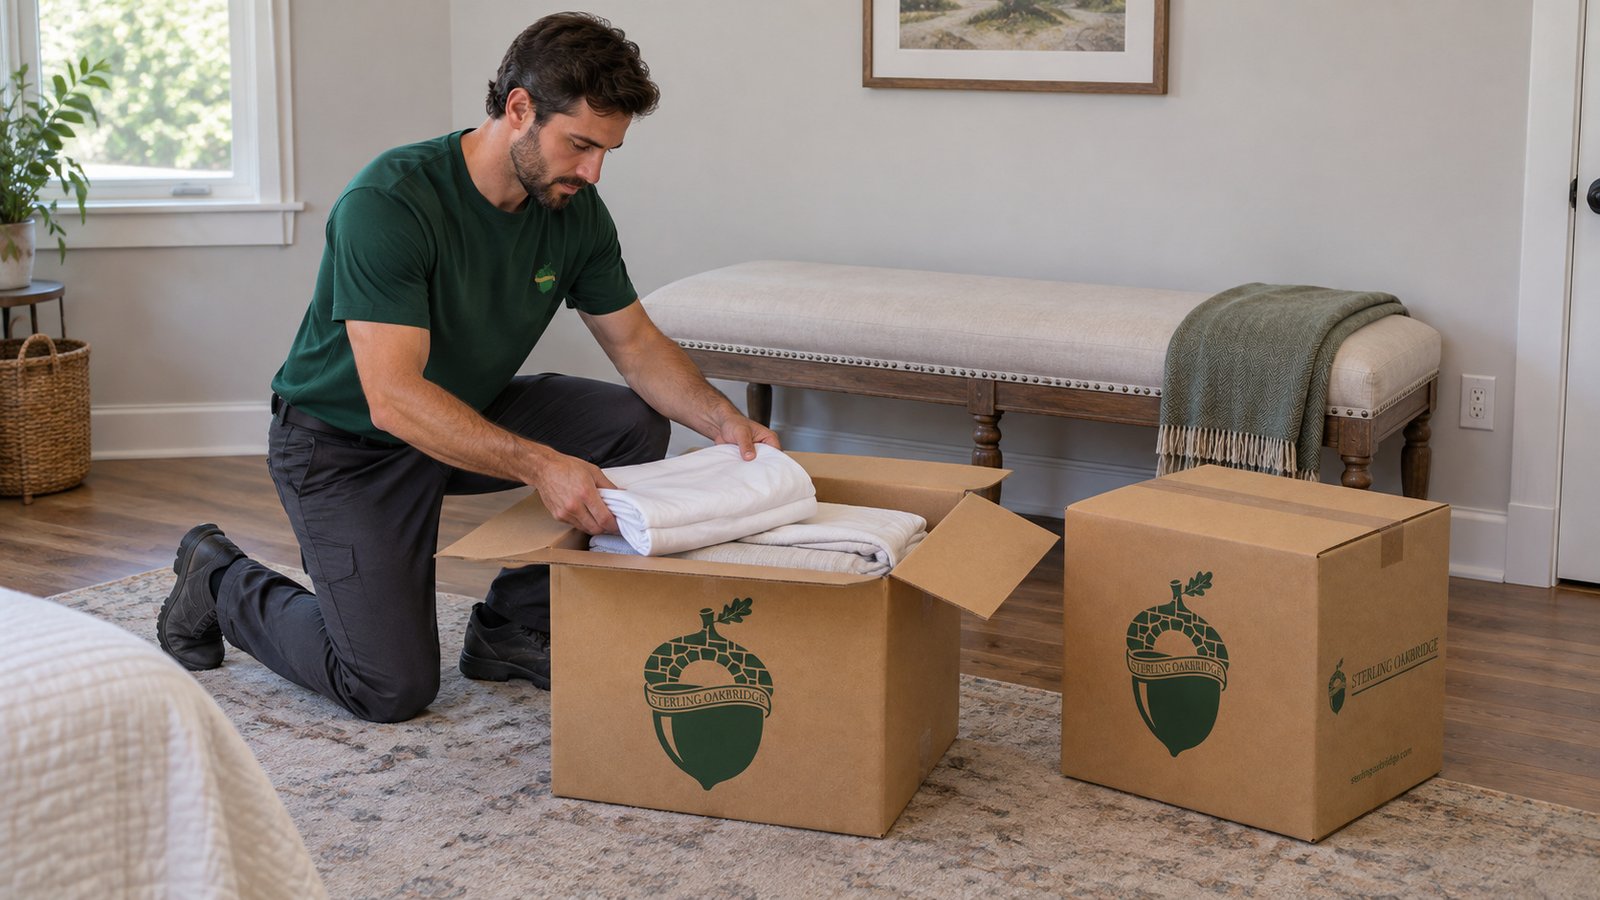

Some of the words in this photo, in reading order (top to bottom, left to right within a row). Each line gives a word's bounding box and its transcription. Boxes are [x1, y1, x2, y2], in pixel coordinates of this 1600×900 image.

[1131, 660, 1171, 674] STERLING
[1172, 661, 1222, 675] OAKBRIDGE
[1351, 658, 1393, 689] STERLING
[1393, 637, 1439, 669] OAKBRIDGE
[650, 693, 702, 708] STERLING
[704, 688, 766, 703] OAKBRIDGE
